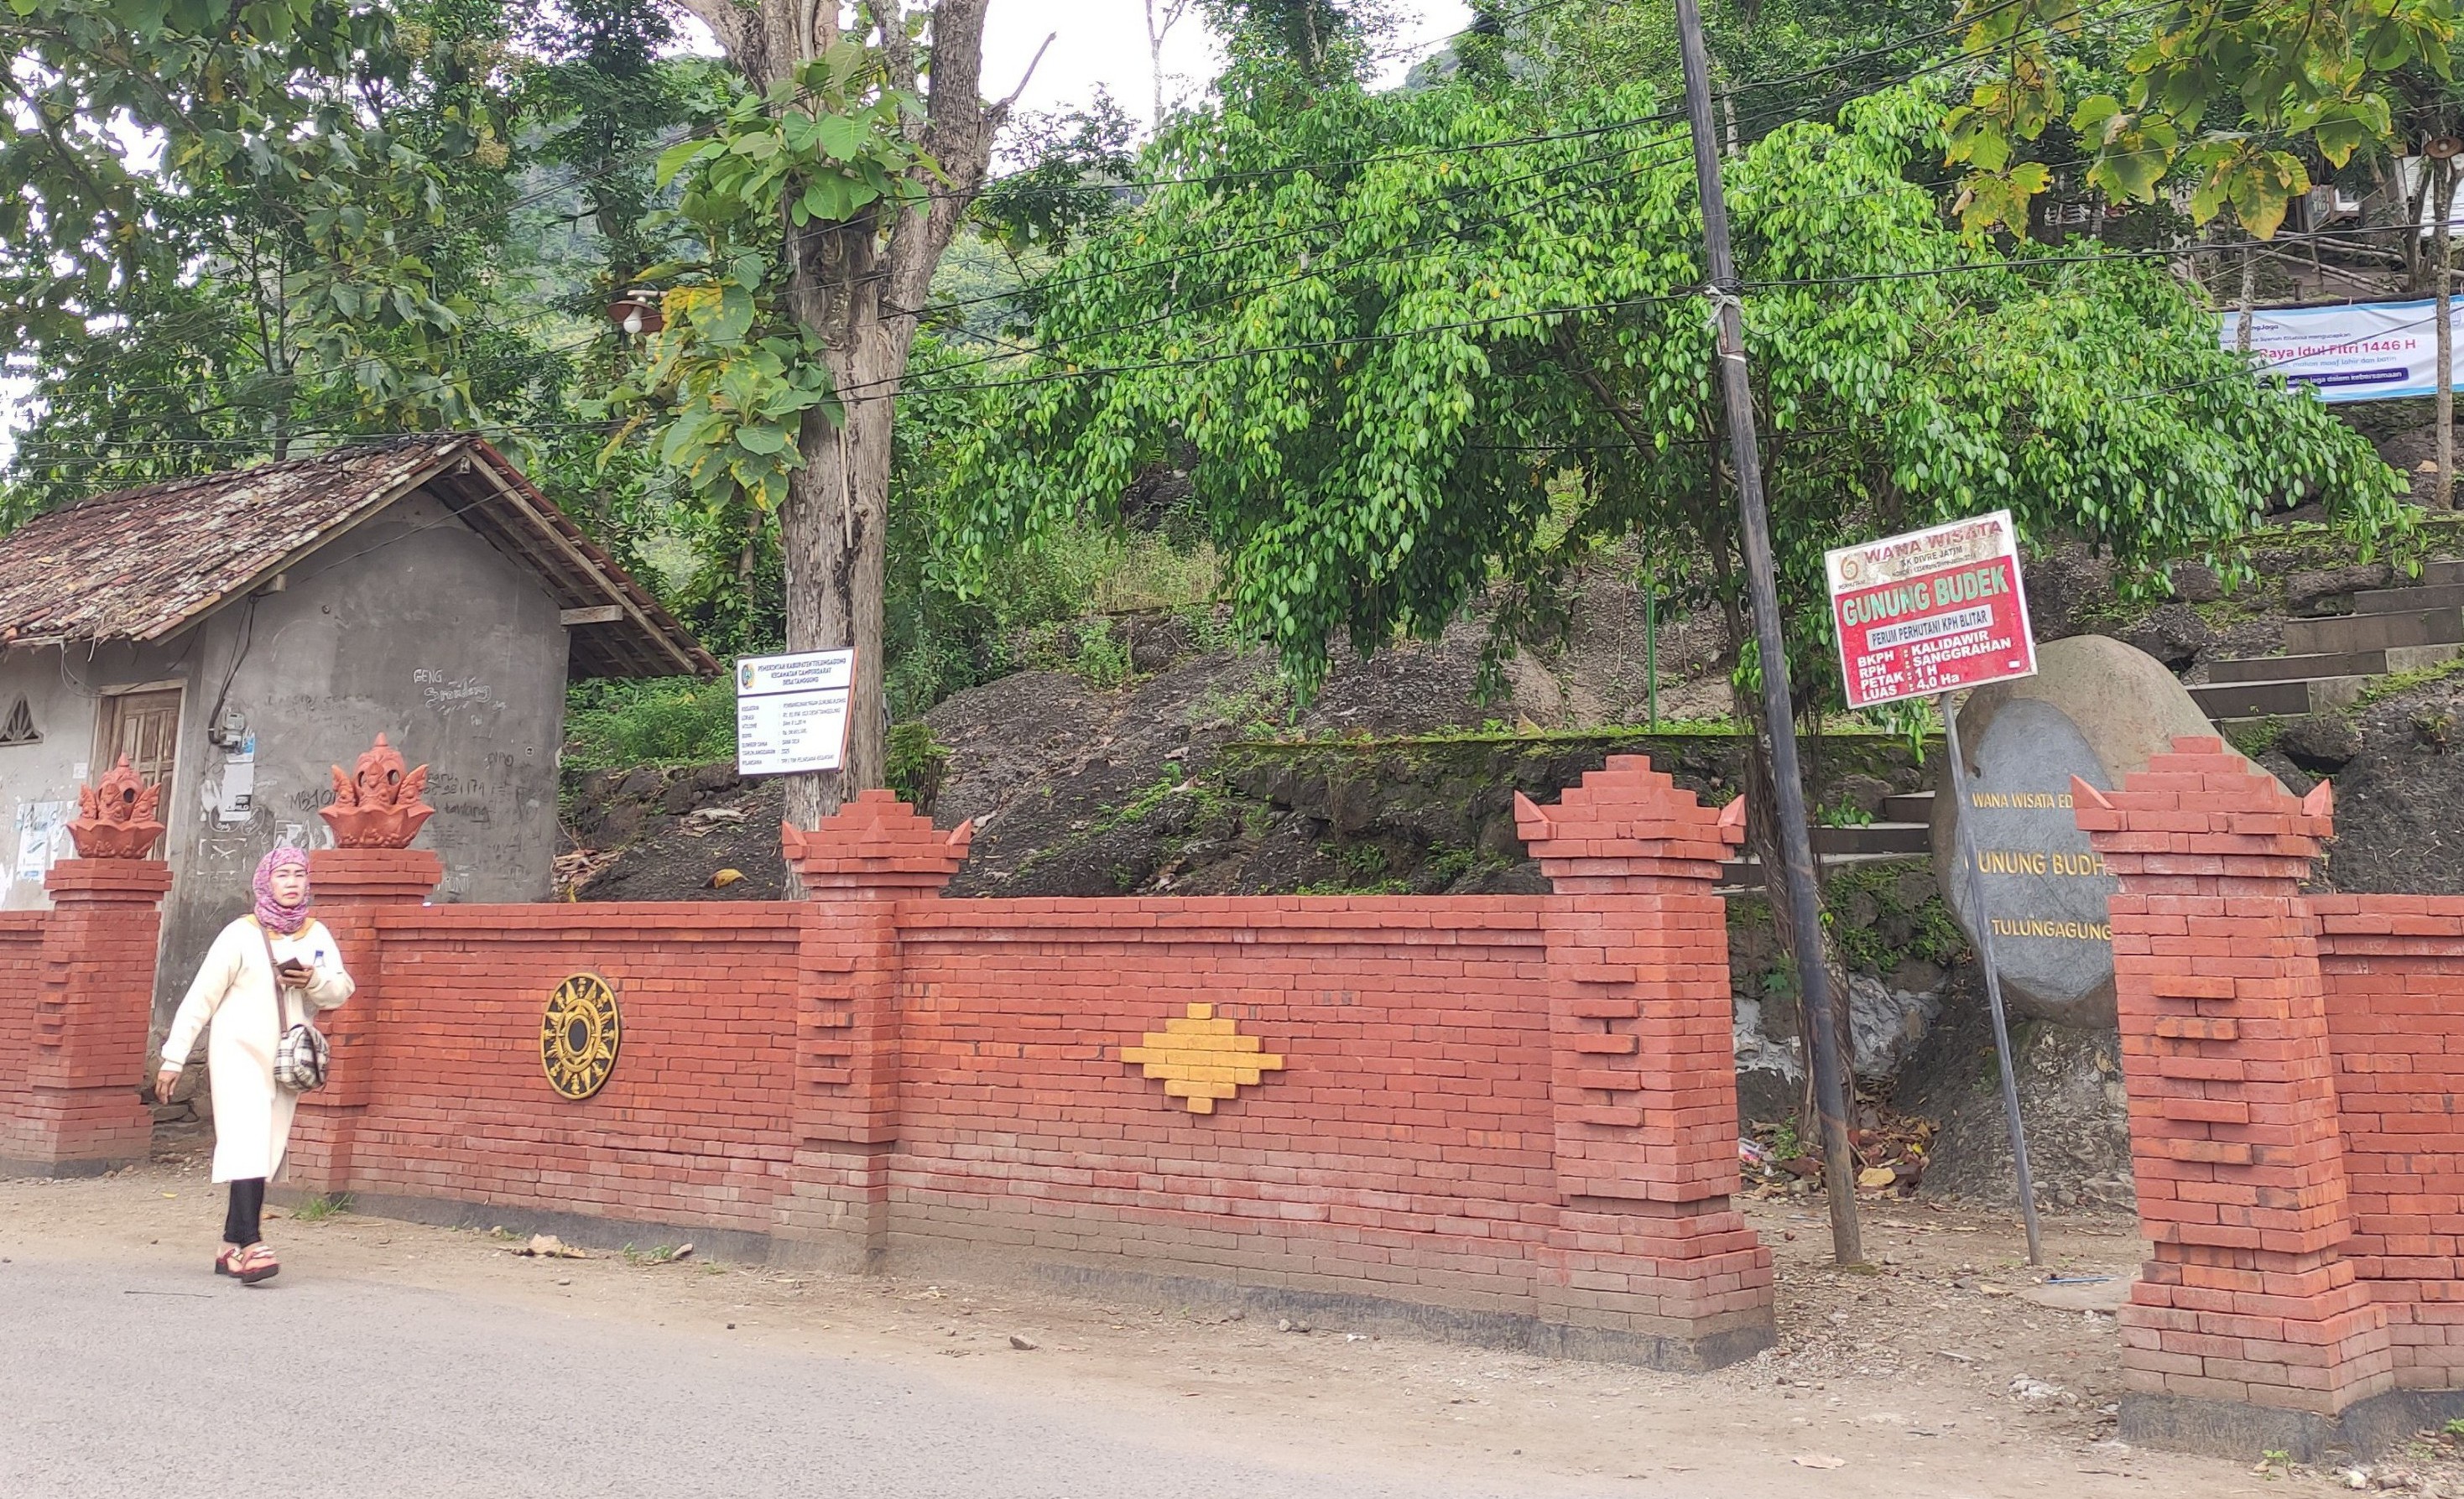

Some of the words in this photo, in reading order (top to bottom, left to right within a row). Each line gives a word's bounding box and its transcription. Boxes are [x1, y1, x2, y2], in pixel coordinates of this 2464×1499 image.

[2299, 345, 2325, 357] Idul
[2330, 343, 2358, 355] Fitri
[2362, 340, 2400, 353] 1446
[2404, 339, 2416, 350] H
[1864, 540, 1921, 564] WANA
[1925, 520, 2003, 548] WISATA
[1914, 552, 1937, 565] DIVRE
[1939, 545, 1963, 559] JATIM
[1842, 582, 1930, 627] GUNUNG
[1934, 565, 2009, 607] BUDEK
[1872, 630, 1898, 647] PERUM
[1899, 621, 1940, 641] PERHUTANI
[1943, 617, 1958, 632] KPH
[1961, 610, 1987, 628] BLITAR
[1857, 650, 1894, 668] BKPH
[1911, 630, 1989, 656] KALIDAWIR
[1858, 664, 1887, 679] RPH
[1913, 638, 2012, 668] SANGGRAHAN
[1860, 672, 1904, 690] PETAK
[1915, 668, 1924, 679] 1
[1927, 664, 1938, 675] H
[1862, 685, 1897, 701] LUAS
[1917, 676, 1938, 690] 4,0
[1940, 673, 1960, 685] Ha
[1972, 792, 2008, 808] WANA
[2011, 793, 2055, 809] WISATA
[2059, 794, 2073, 809] ED
[1965, 851, 2046, 876] UNUNG
[2052, 852, 2117, 877] BUDH
[1992, 919, 2112, 941] TULUNGAGUNG
